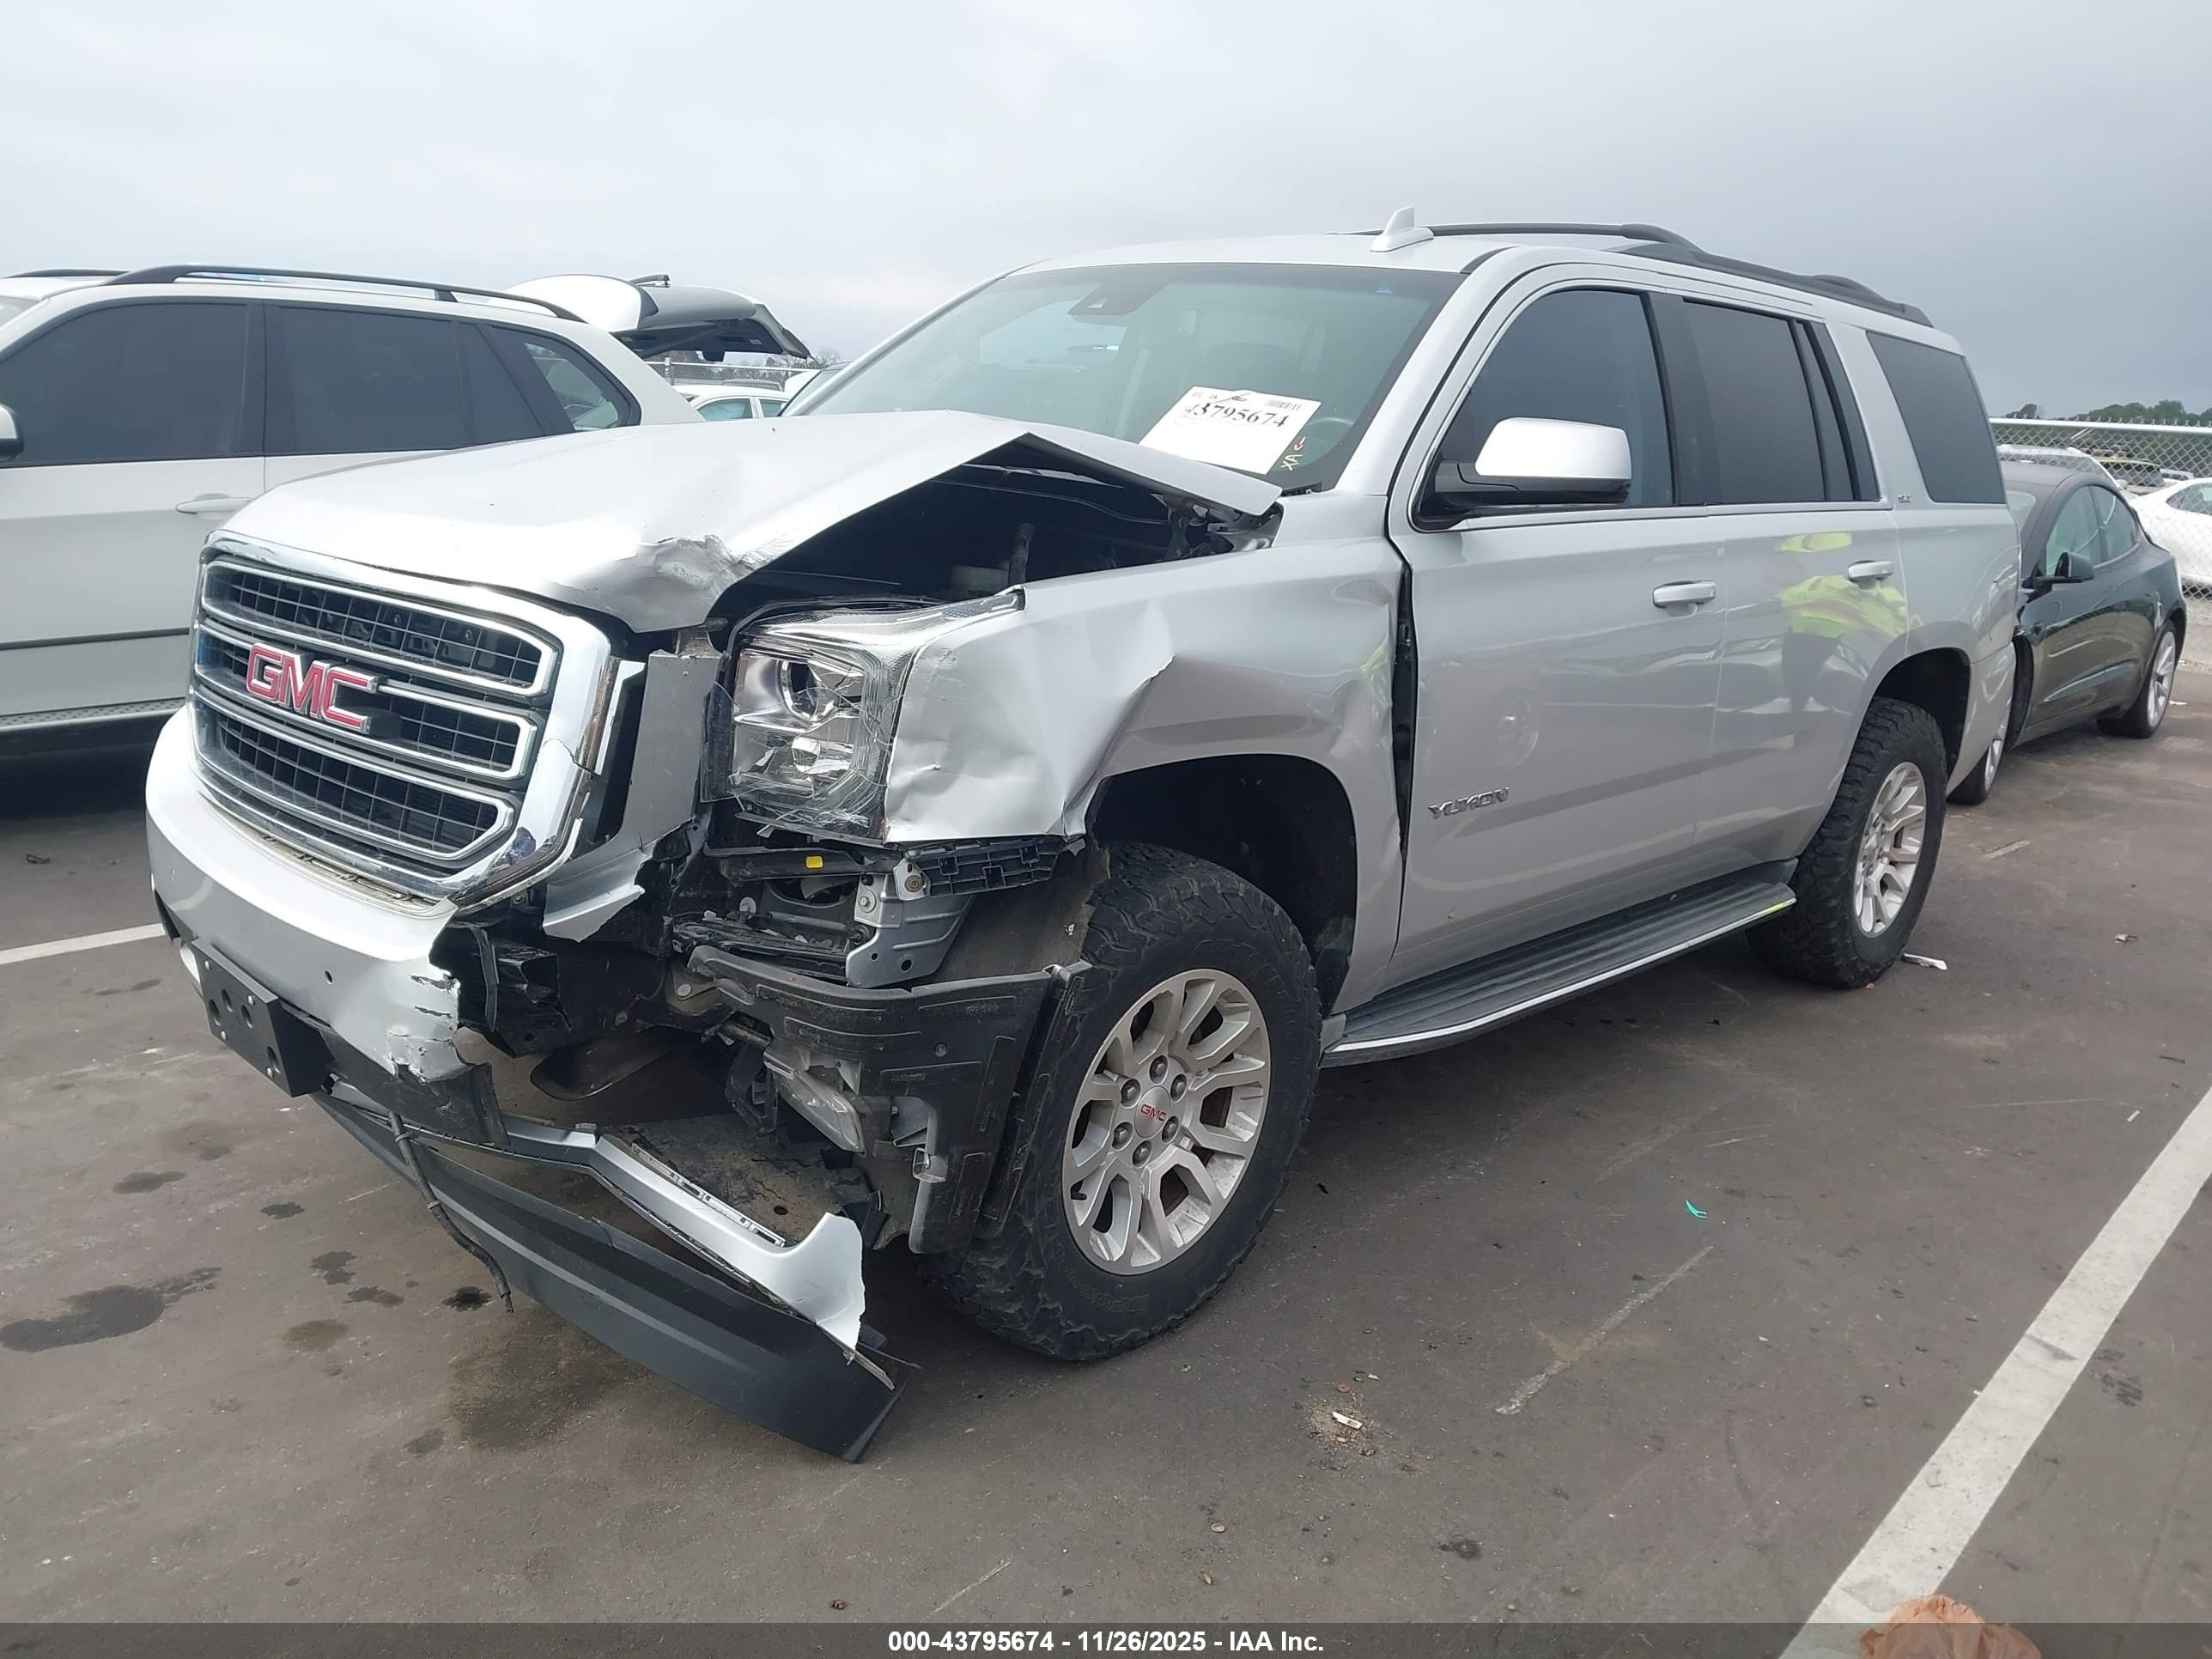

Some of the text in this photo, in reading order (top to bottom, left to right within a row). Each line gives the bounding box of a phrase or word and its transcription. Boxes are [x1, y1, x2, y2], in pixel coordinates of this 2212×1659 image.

[246, 643, 379, 734] GMC
[1428, 787, 1510, 819] YUKON
[1140, 1103, 1167, 1121] GMC
